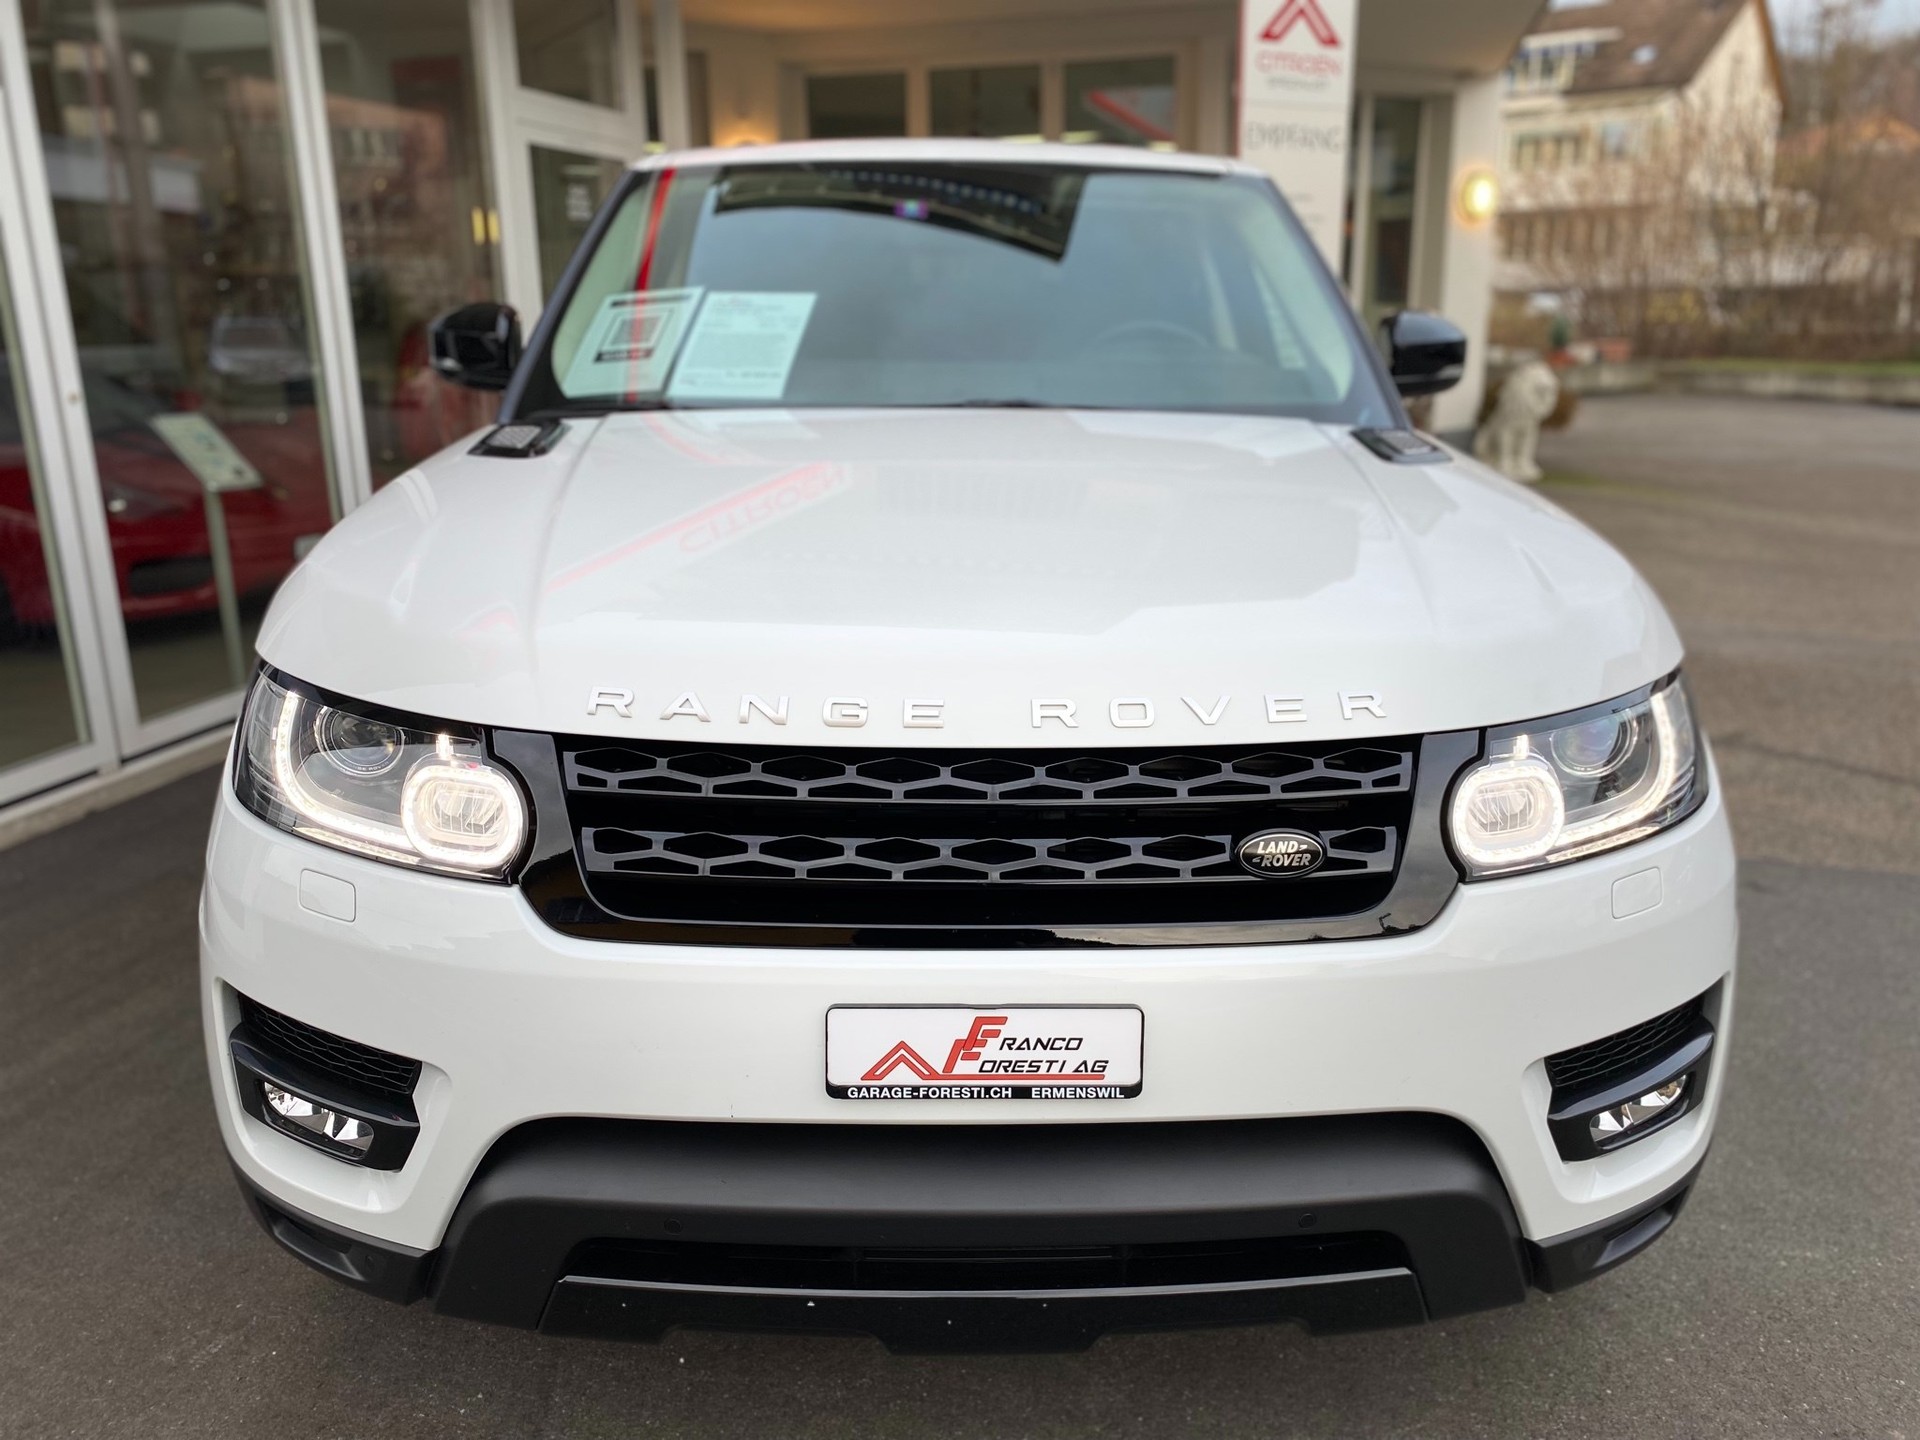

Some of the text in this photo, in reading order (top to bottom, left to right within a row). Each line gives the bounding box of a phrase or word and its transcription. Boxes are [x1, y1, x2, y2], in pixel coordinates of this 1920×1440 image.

[587, 686, 1387, 728] RANGE ROVER
[1257, 841, 1299, 854] LAND
[1261, 853, 1312, 867] ROVER
[1073, 1060, 1109, 1074] AG
[847, 1087, 1125, 1099] GARAGE-FORESTI.CH ERMENSWIL
